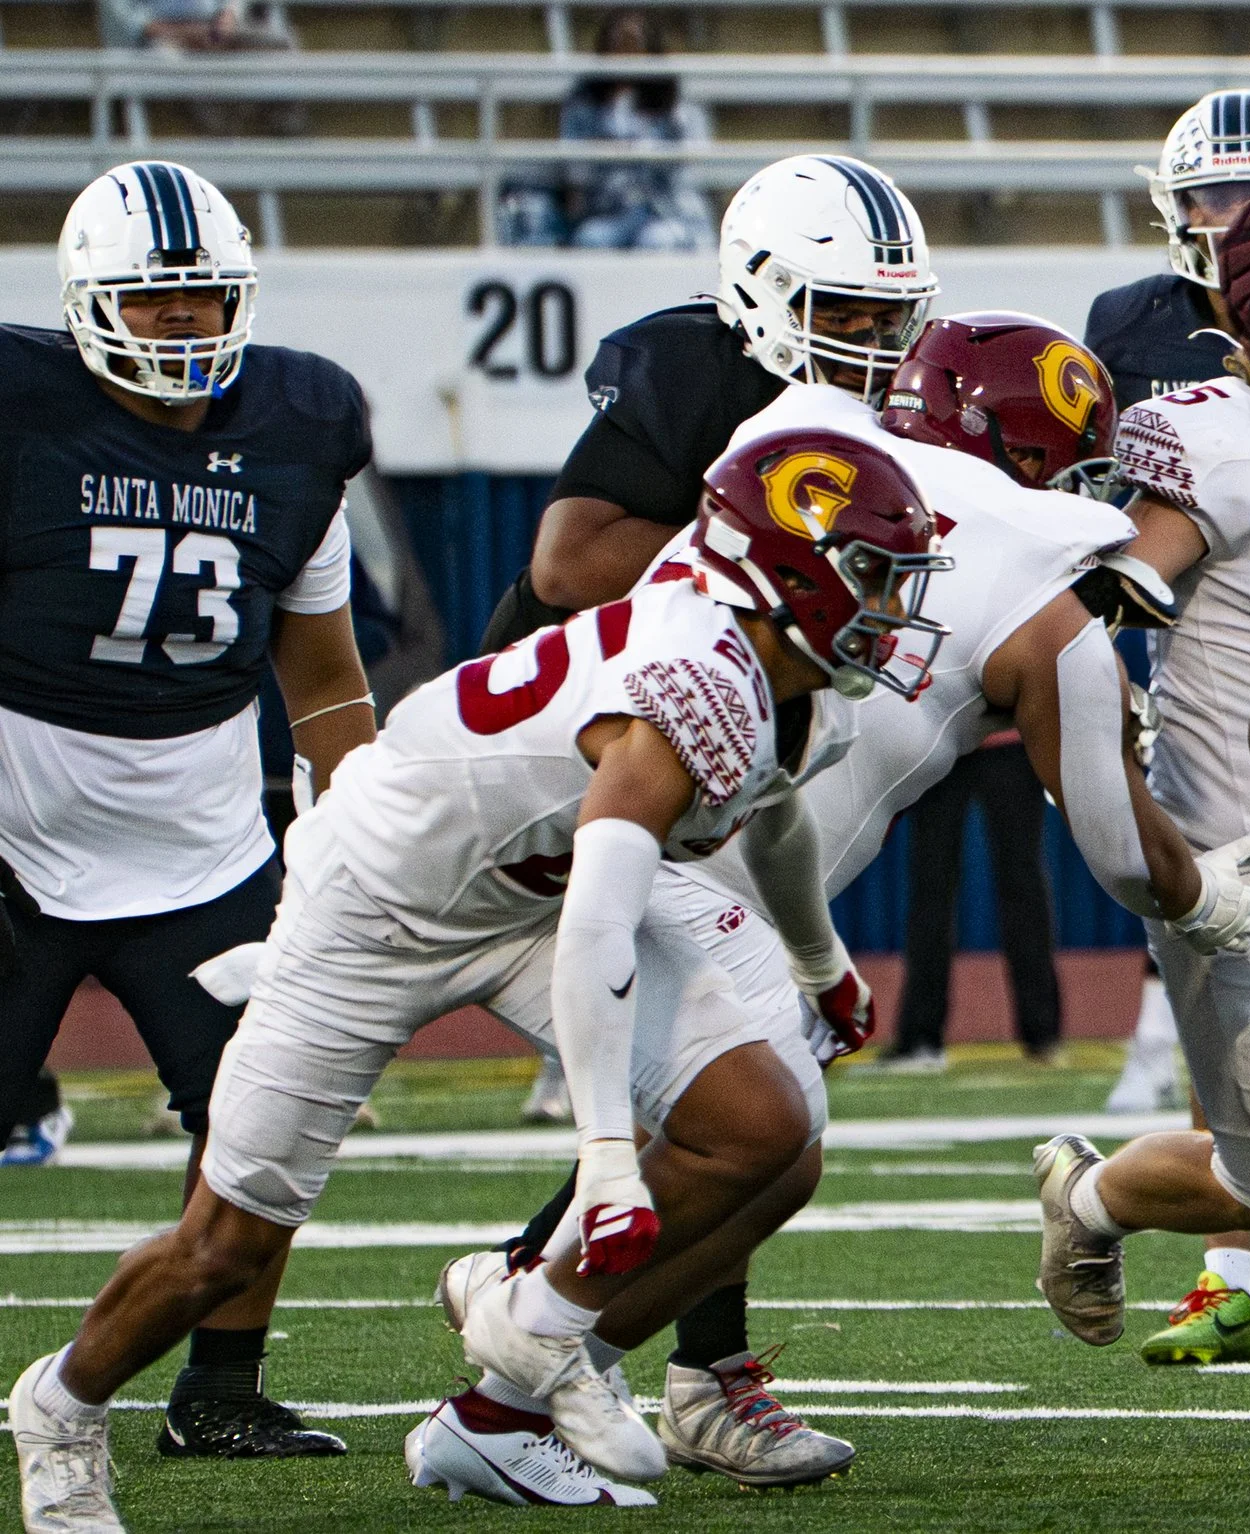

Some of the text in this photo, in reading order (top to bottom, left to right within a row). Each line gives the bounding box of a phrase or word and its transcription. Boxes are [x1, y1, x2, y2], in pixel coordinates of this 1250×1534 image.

[464, 275, 577, 382] 20
[1033, 340, 1099, 435] G
[81, 474, 257, 534] SANTA MONICA
[761, 451, 858, 541] G
[88, 526, 241, 665] 73
